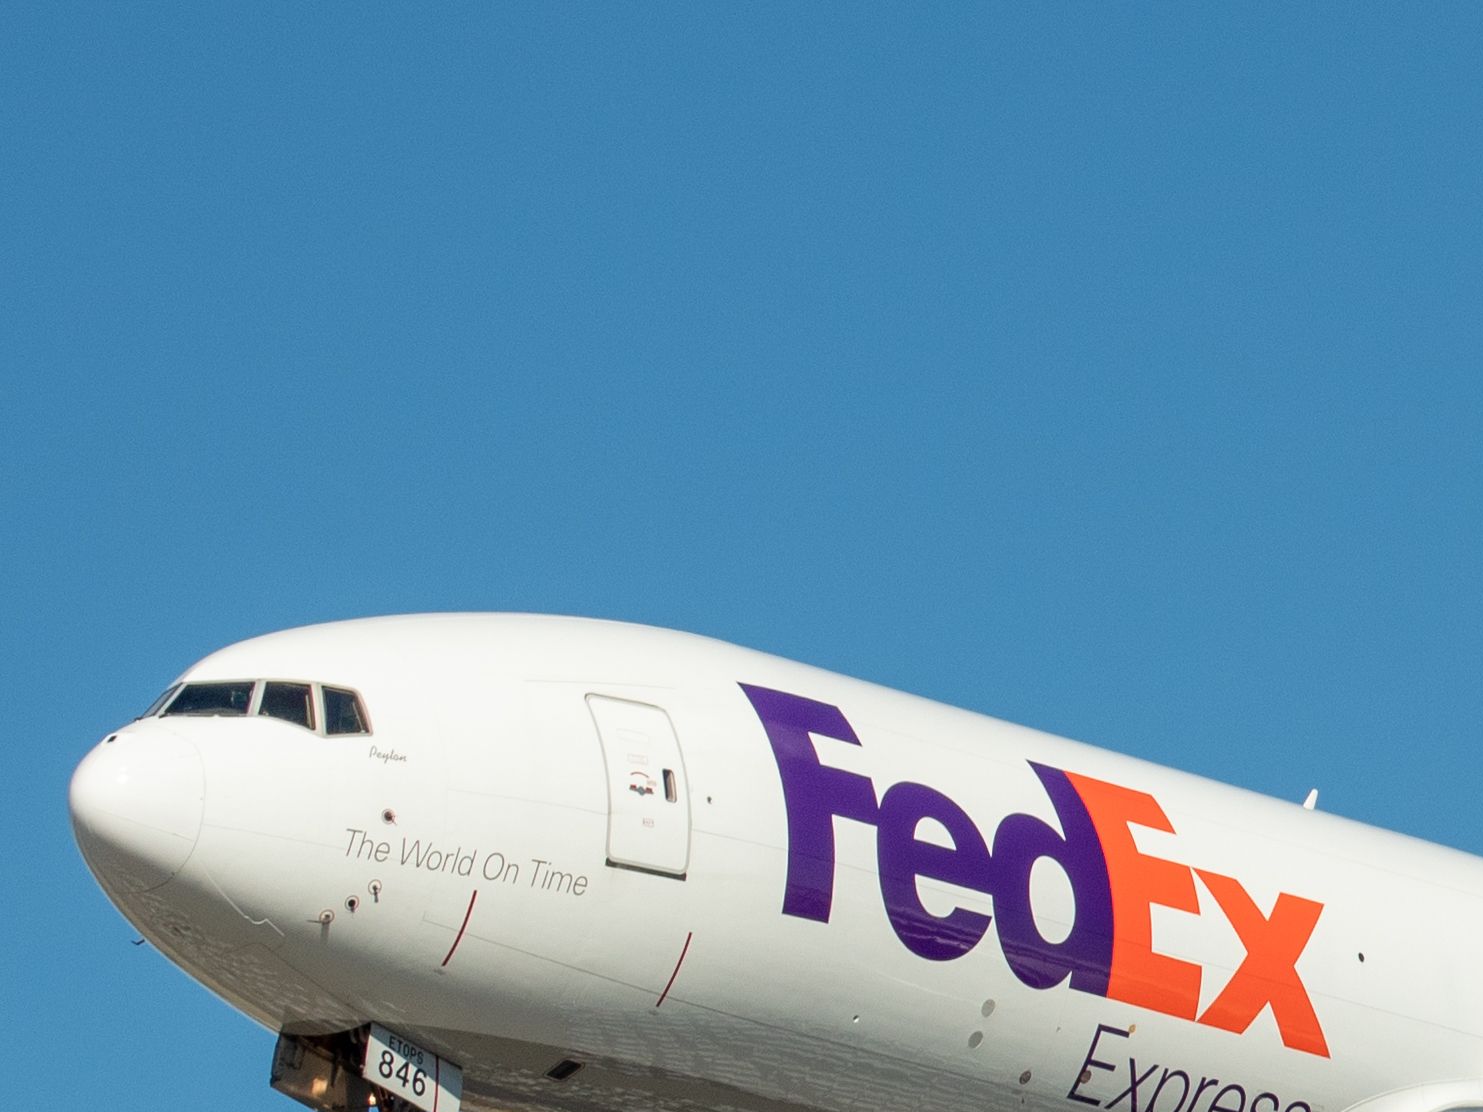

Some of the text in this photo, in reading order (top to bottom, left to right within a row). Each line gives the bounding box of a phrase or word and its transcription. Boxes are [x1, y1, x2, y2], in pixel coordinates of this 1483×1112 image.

[346, 828, 588, 896] The World On Time
[736, 681, 1331, 1059] FedEx
[379, 1050, 427, 1097] 846
[389, 1036, 424, 1065] ETOPS
